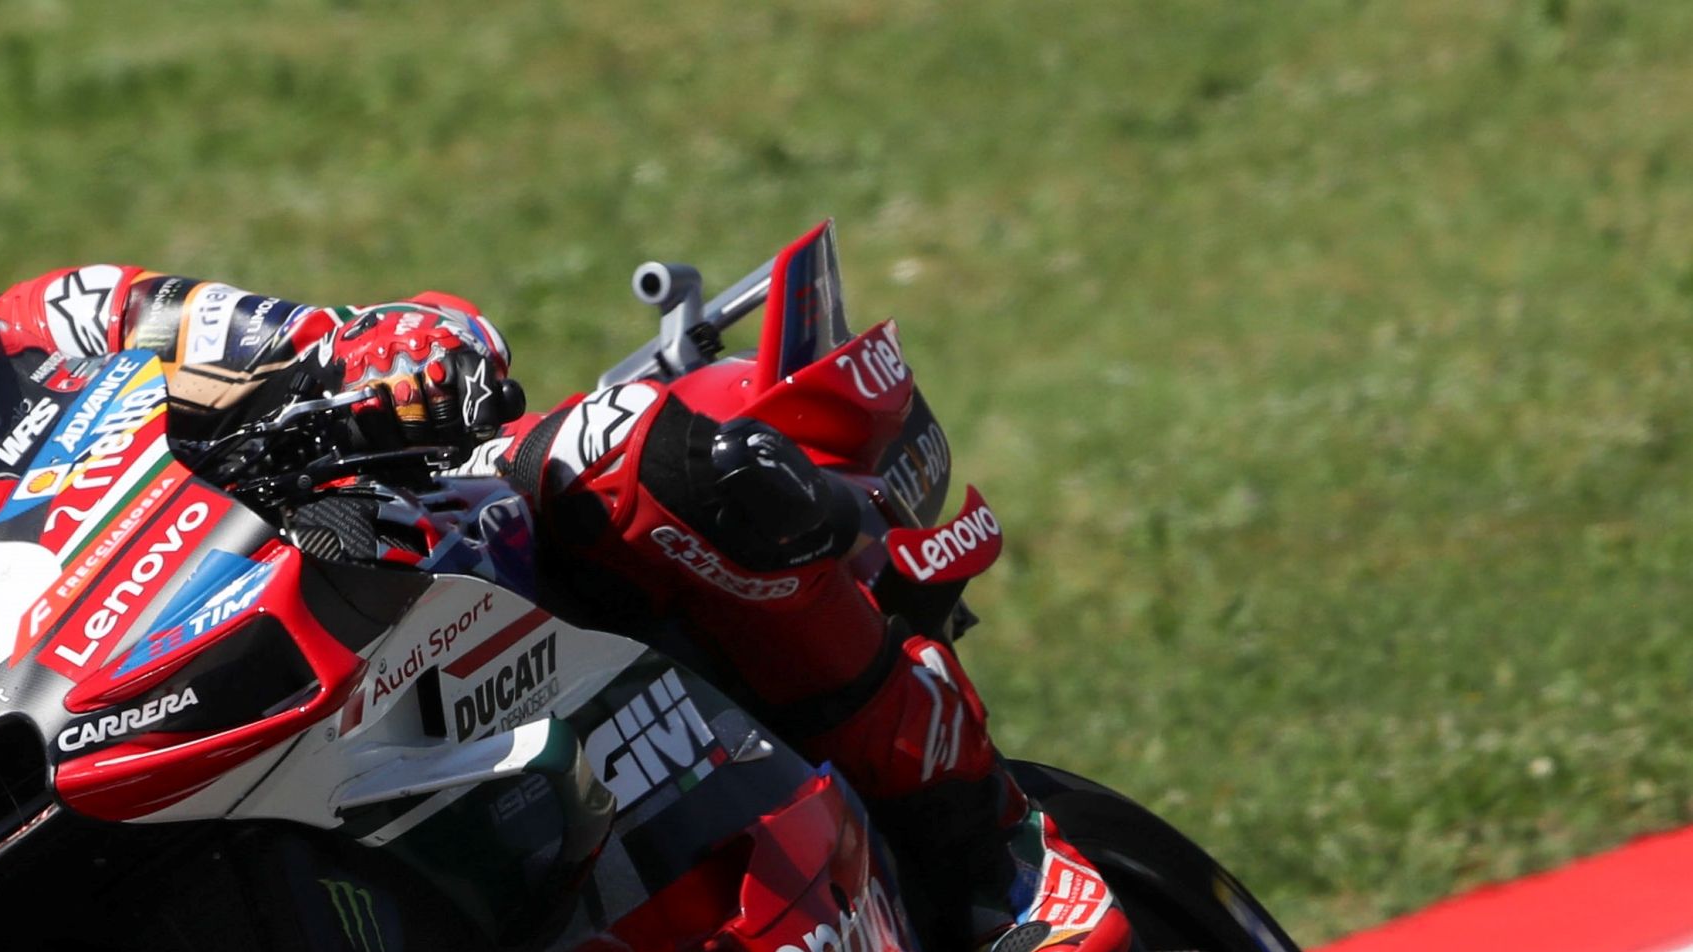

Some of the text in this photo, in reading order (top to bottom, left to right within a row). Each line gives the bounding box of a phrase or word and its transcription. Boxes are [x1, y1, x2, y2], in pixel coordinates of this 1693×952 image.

[53, 356, 140, 453] ADVANCE
[54, 500, 209, 669] Lenovo
[58, 477, 176, 597] FRECCIAROSSA
[898, 505, 999, 581] Lenovo
[189, 585, 266, 637] TIM
[371, 591, 494, 706] Audi Sport
[58, 686, 199, 753] CARRERA
[454, 631, 558, 744] DUCATI
[585, 667, 715, 813] GIVI
